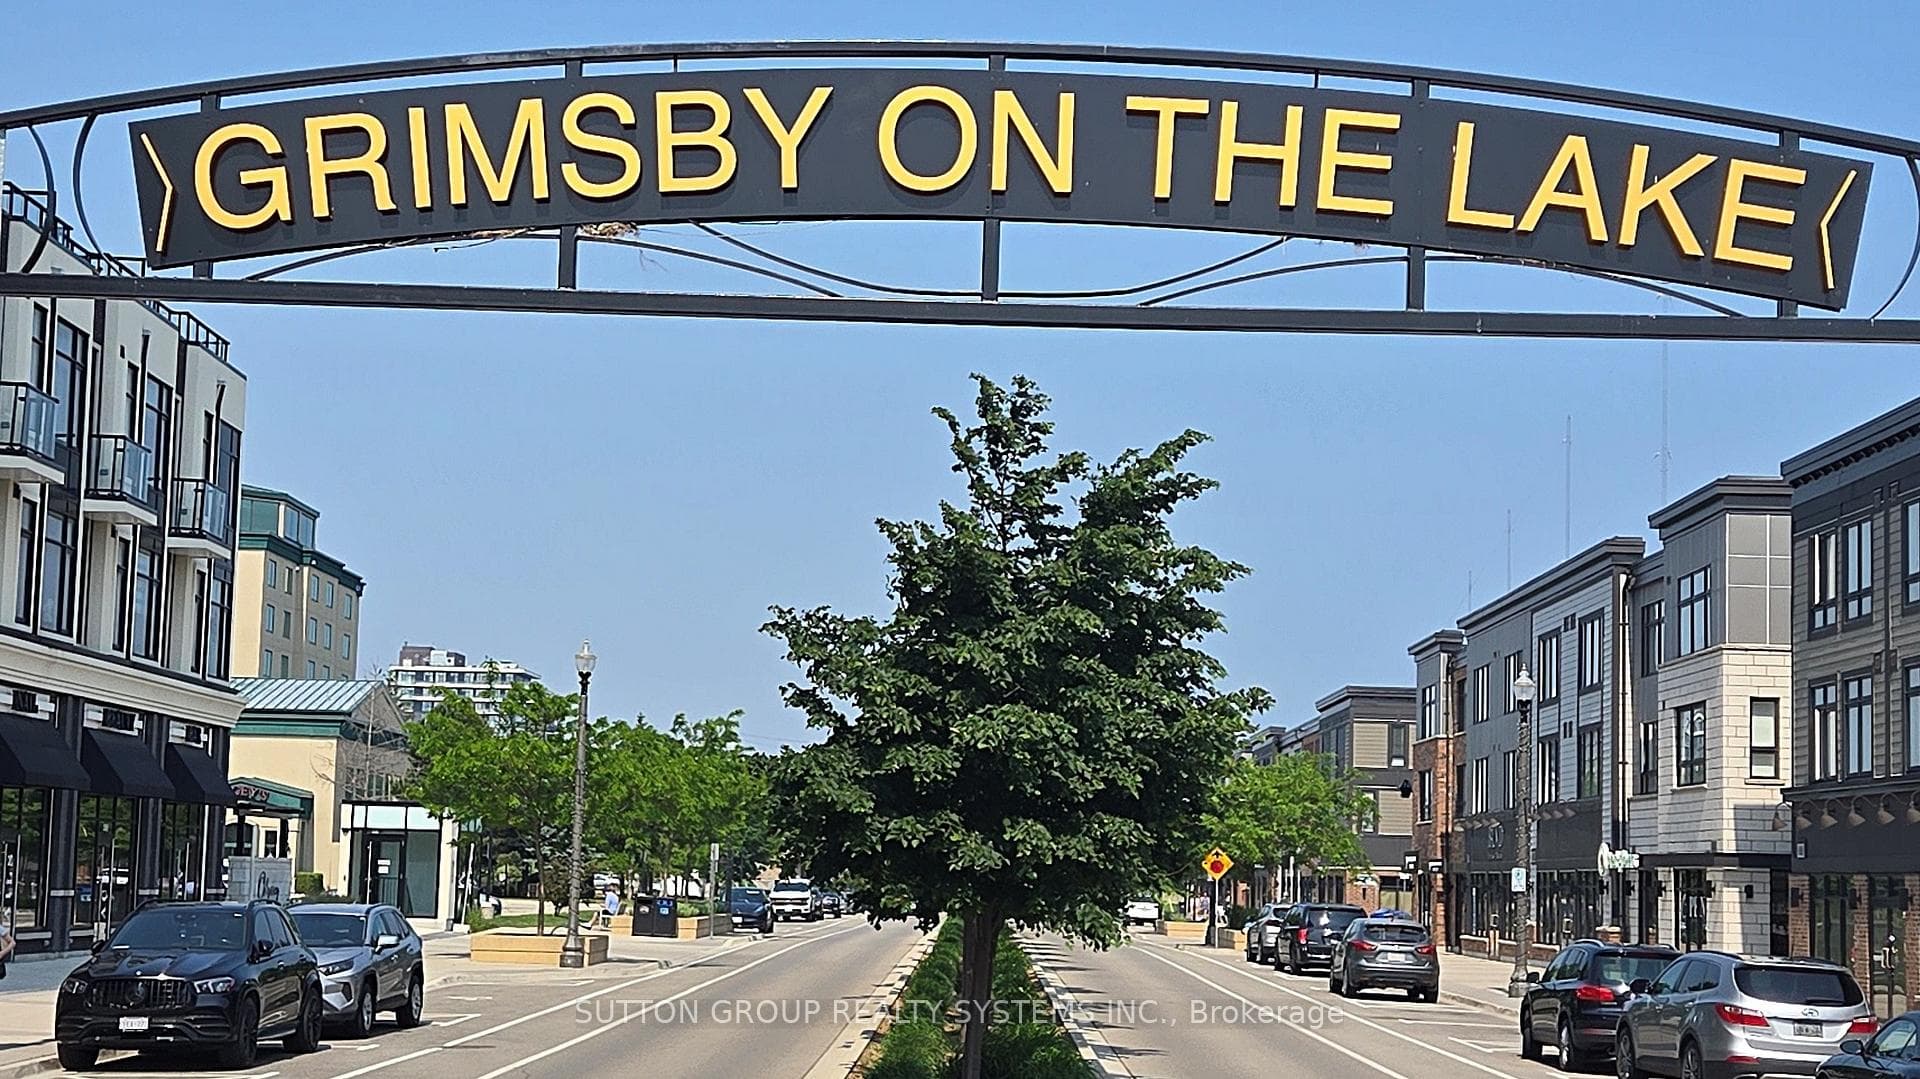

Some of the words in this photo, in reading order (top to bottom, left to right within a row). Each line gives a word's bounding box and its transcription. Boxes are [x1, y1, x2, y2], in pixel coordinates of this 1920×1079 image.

[195, 86, 833, 232] GRIMSBY
[879, 86, 1075, 194] ON
[1126, 96, 1401, 217] THE
[1448, 121, 1807, 271] LAKE
